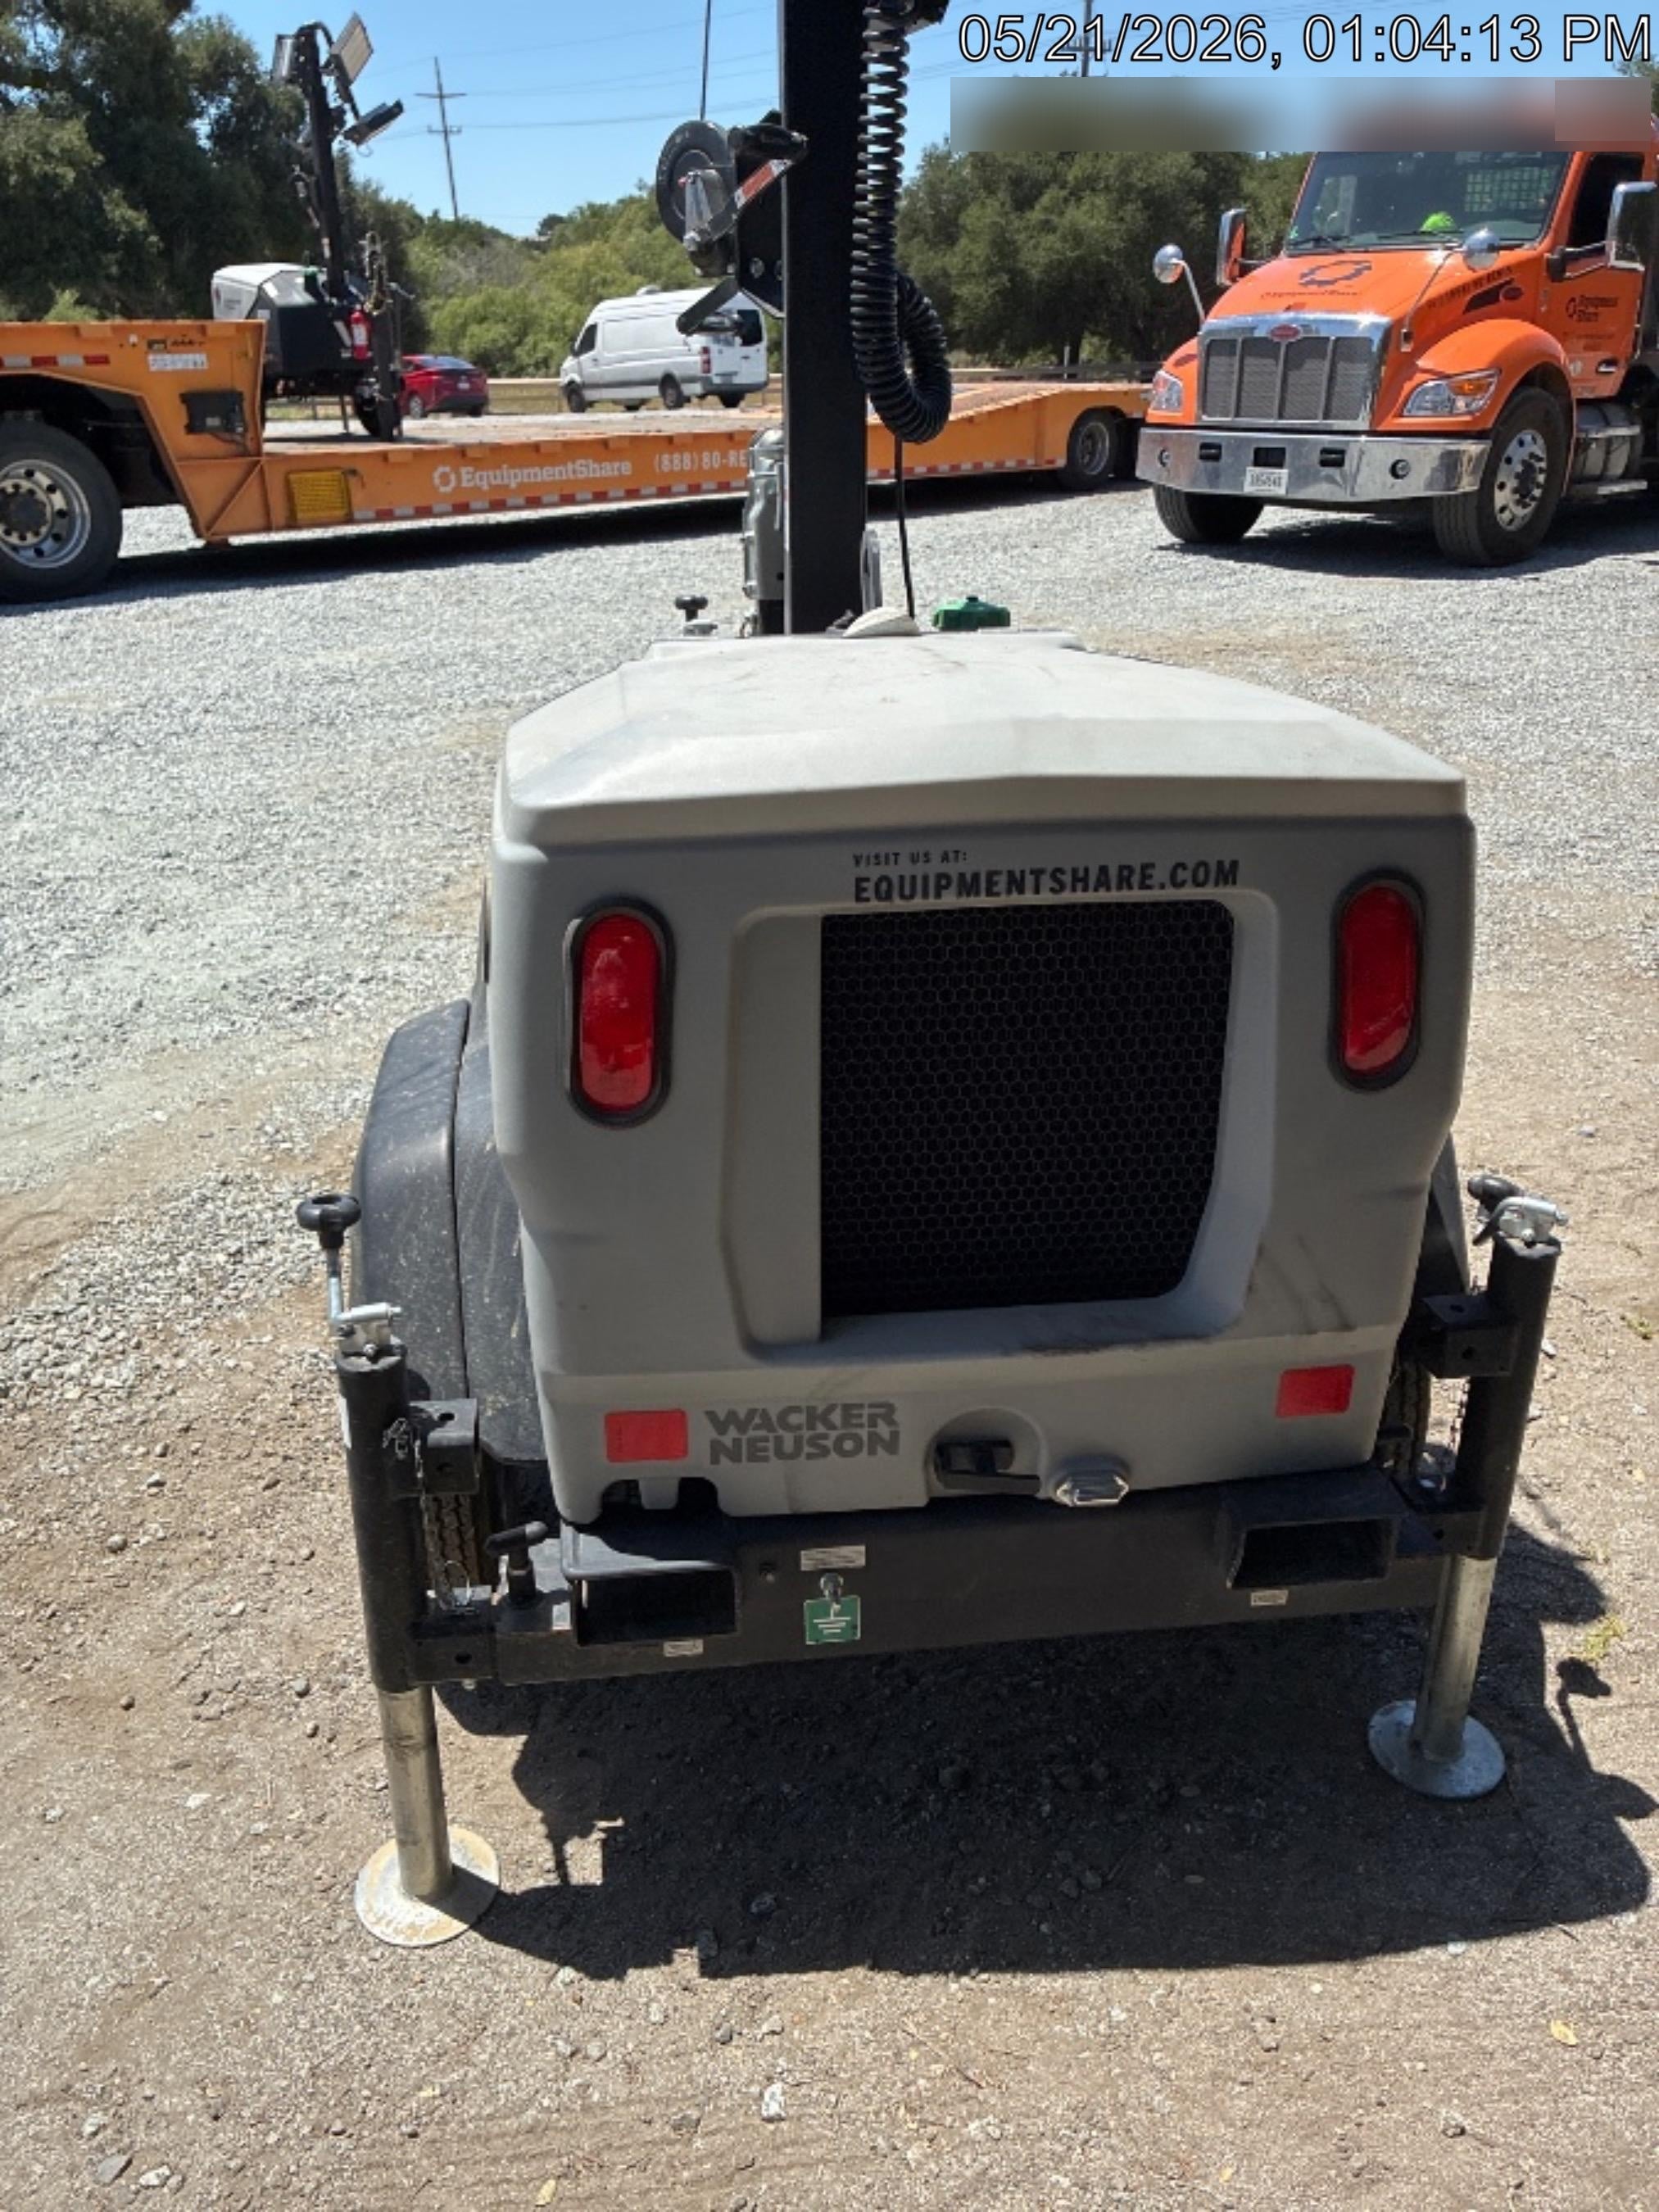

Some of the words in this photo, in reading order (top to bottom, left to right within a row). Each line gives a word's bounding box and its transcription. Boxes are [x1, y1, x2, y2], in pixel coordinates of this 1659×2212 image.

[460, 458, 632, 492] EquipmentShare
[654, 451, 697, 473] (888)
[853, 851, 900, 868] VISIT
[909, 850, 931, 865] US
[941, 850, 968, 863] AT:
[854, 859, 1240, 903] EQUIPMENTSHARE.COM
[704, 1401, 899, 1436] WACKER
[709, 1430, 900, 1466] NEUSON
